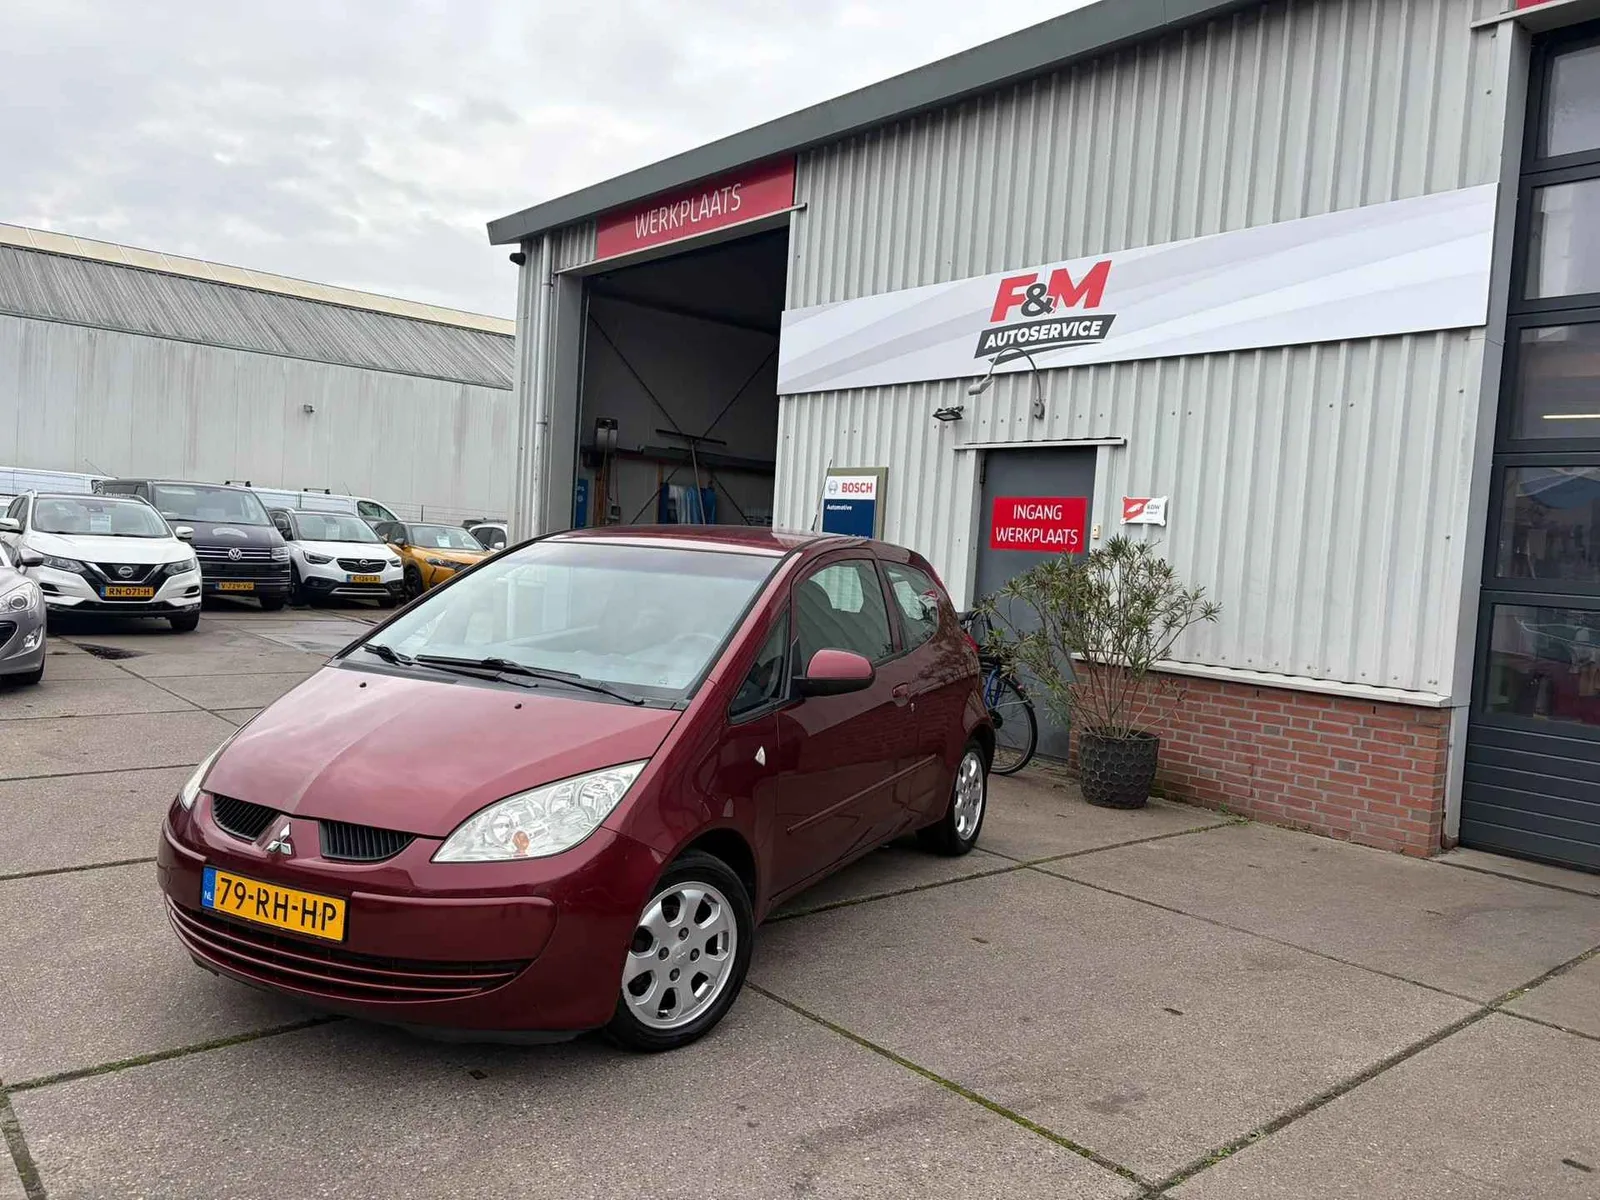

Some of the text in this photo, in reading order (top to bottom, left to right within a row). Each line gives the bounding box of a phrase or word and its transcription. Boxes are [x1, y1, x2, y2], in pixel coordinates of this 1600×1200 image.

[634, 183, 742, 239] WERKPLAATS
[990, 260, 1112, 323] F&M
[984, 320, 1103, 349] AUTOSERVICE
[841, 482, 873, 493] BOSCH
[1013, 504, 1063, 521] INGANG
[996, 526, 1079, 545] WERKPLAATS
[108, 587, 150, 596] RN-071-H
[203, 890, 213, 901] NL
[219, 876, 337, 931] 79-RH-HP
